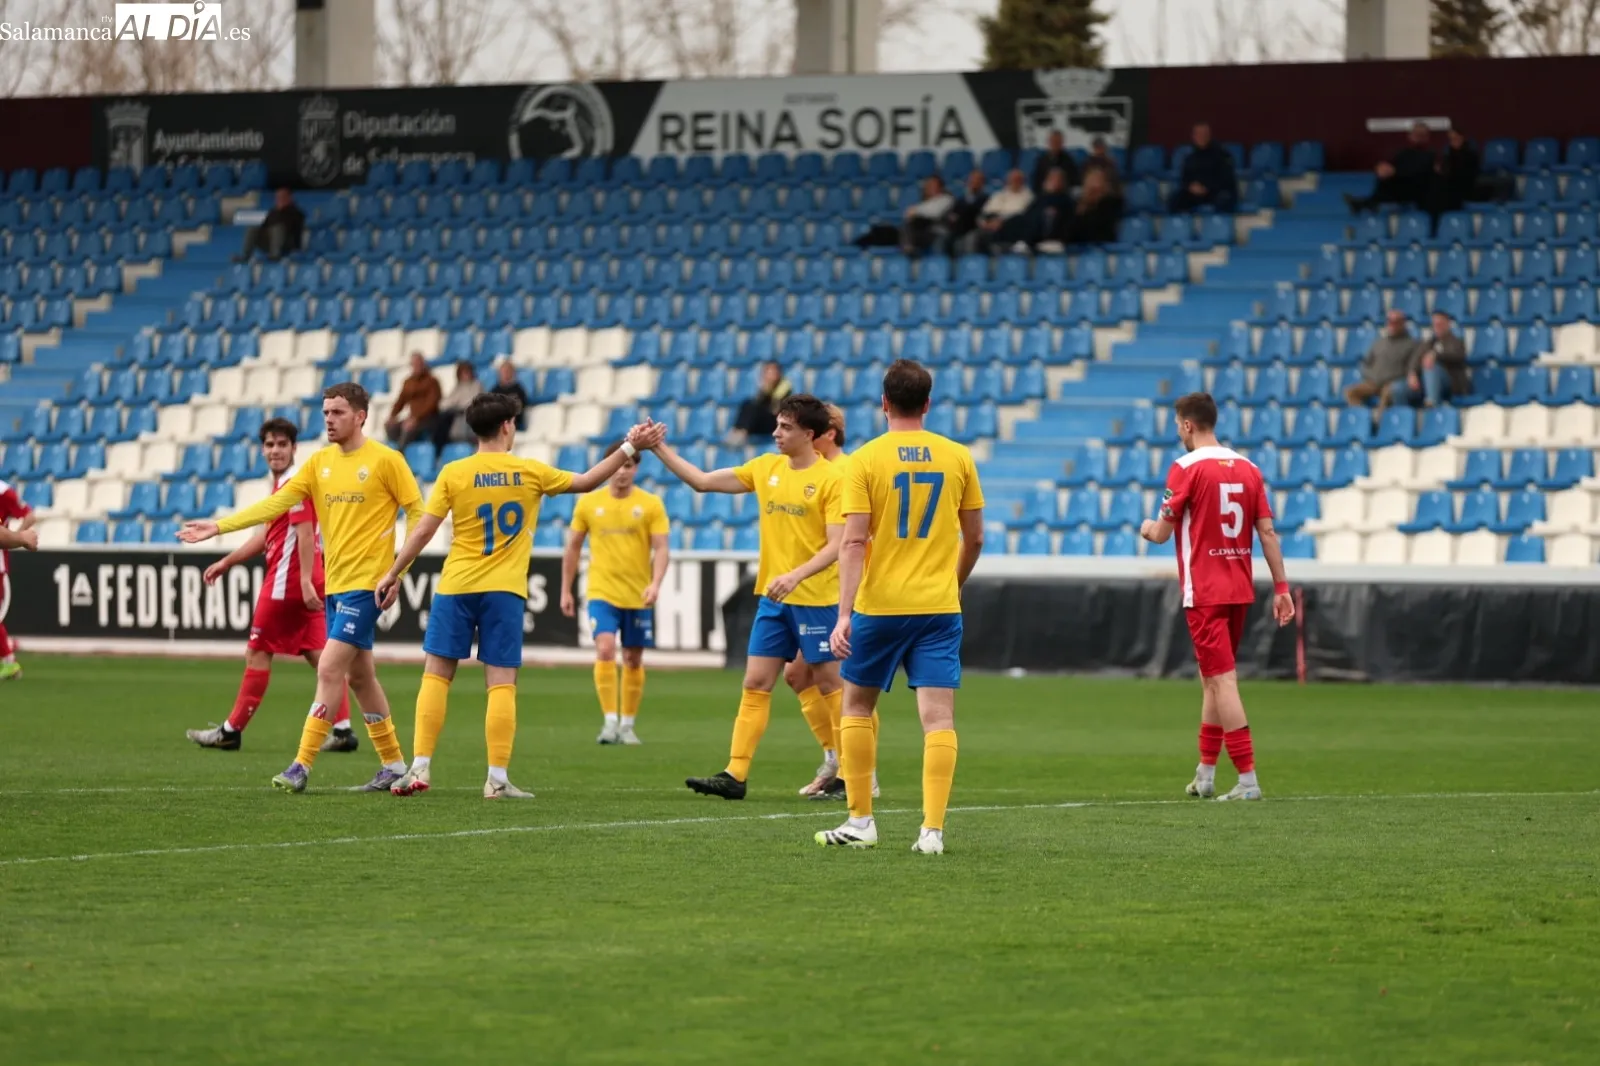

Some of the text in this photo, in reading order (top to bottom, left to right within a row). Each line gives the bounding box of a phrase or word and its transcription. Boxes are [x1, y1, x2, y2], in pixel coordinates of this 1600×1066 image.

[659, 94, 970, 152] REINA SOFÍA
[897, 445, 932, 462] CHEA
[476, 501, 524, 556] 19
[892, 471, 945, 539] 17
[1218, 482, 1244, 539] 5
